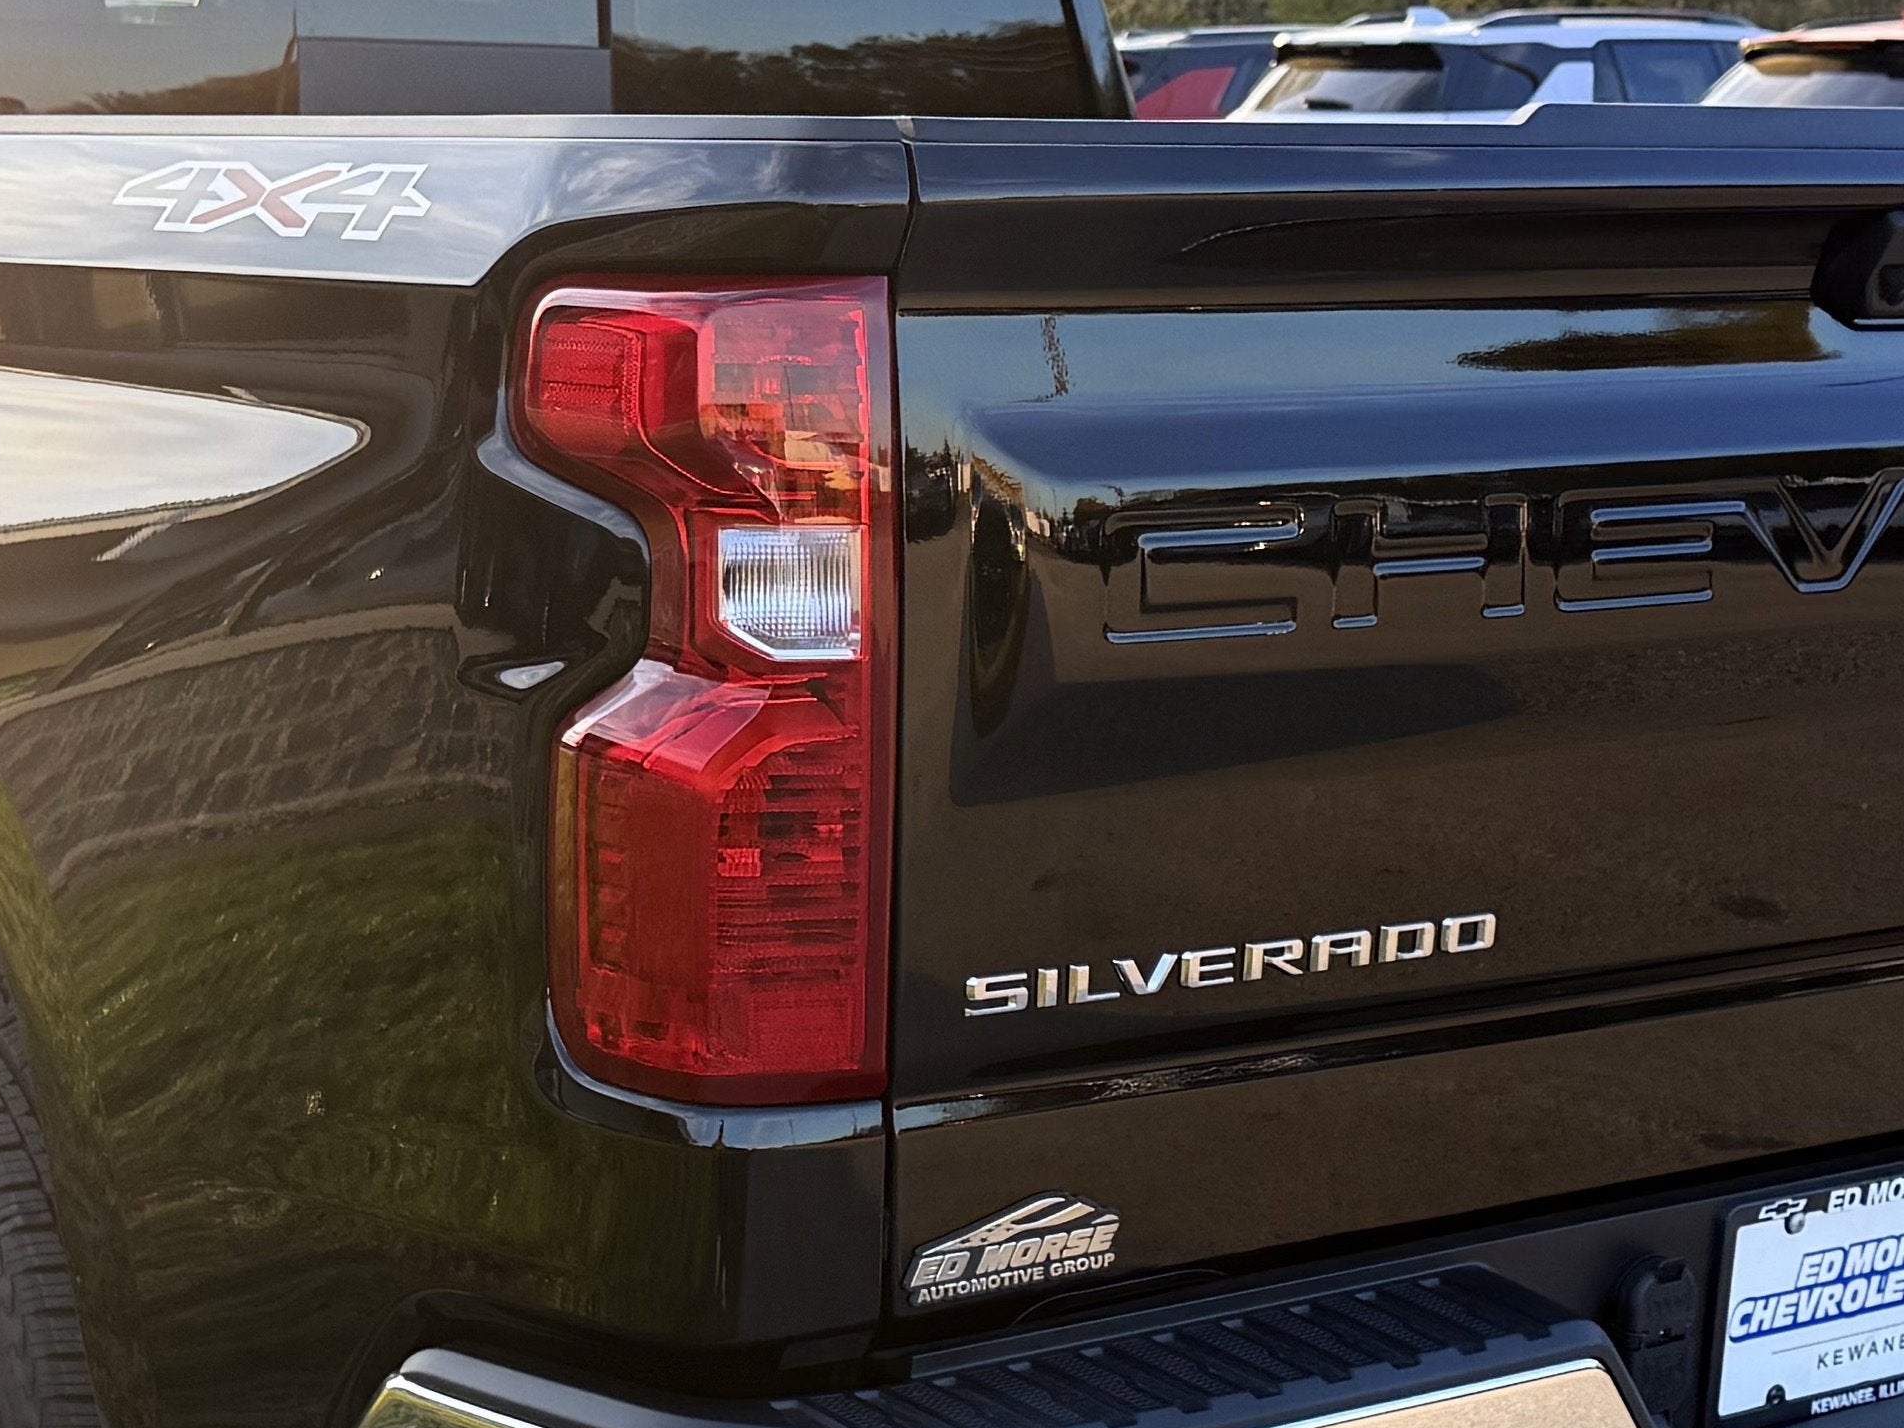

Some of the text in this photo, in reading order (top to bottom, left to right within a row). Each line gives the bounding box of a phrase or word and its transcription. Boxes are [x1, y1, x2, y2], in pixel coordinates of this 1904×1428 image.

[964, 913, 1497, 1018] SILVERADO
[1827, 1186, 1863, 1213] ED
[910, 1223, 1120, 1289] ED MORSE
[917, 1253, 1116, 1305] AUTOMOTIVE GROUP
[1795, 1246, 1847, 1290] ED
